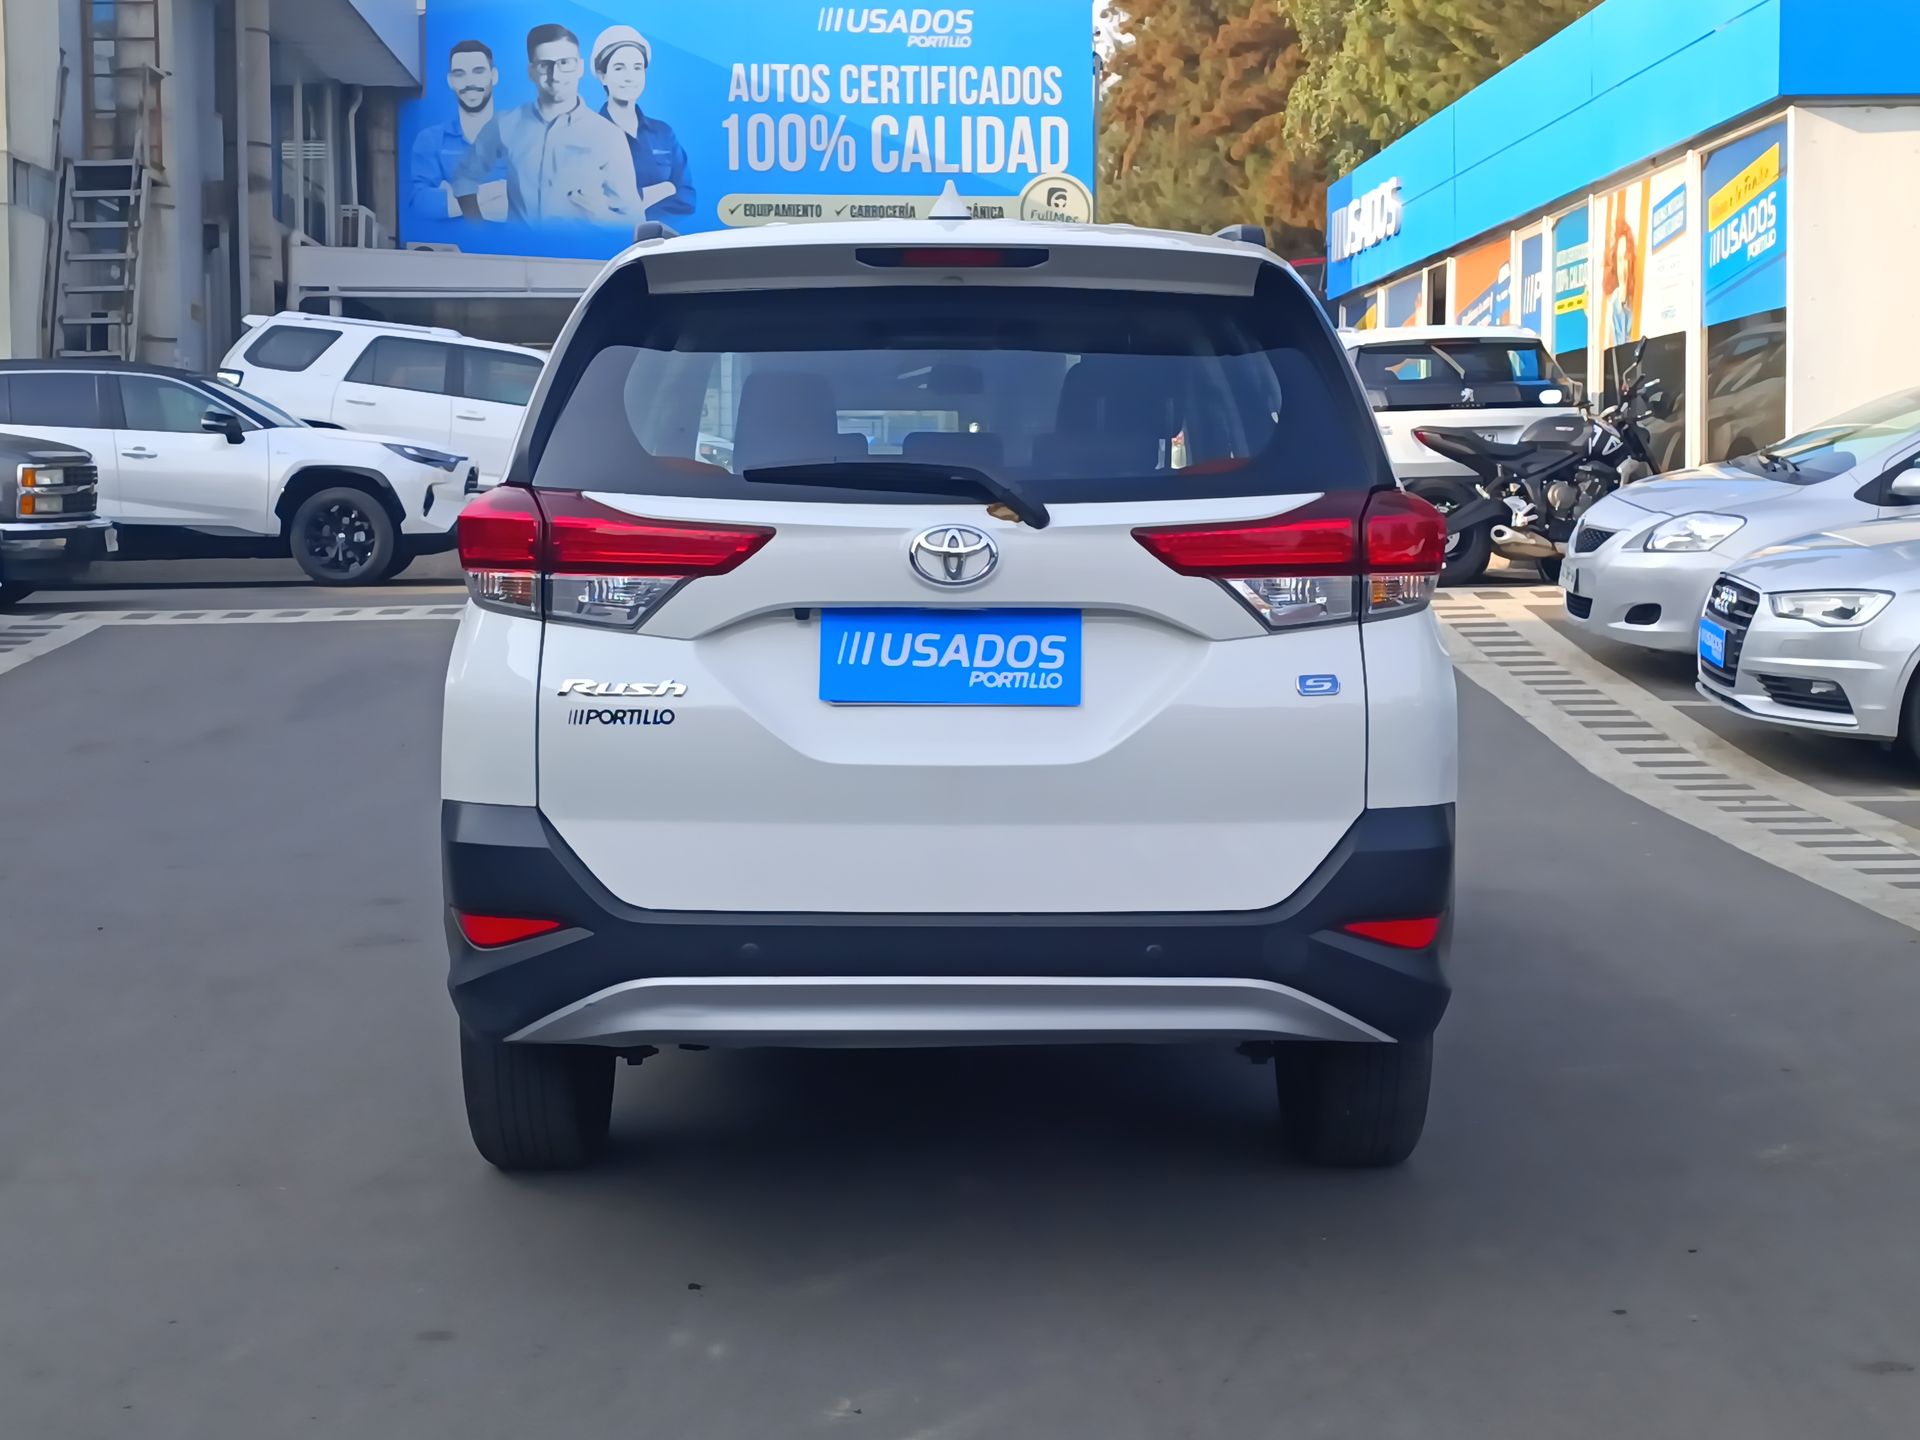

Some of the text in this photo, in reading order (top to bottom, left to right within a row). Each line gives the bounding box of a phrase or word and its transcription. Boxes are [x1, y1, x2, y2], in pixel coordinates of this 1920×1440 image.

[846, 8, 975, 35] USADOS
[907, 35, 973, 48] PORTILLO
[728, 63, 1063, 106] AUTOS CERTIFICADOS
[721, 113, 1070, 174] 100% CALIDAD
[743, 203, 822, 217] EQUIPAMIENTO
[849, 202, 916, 219] CARROCERÍA
[1721, 190, 1777, 260] USADOS
[880, 632, 1067, 670] USADOS
[557, 678, 688, 697] Rush
[968, 670, 1064, 689] PORTILLO
[585, 708, 676, 726] PORTILLO
